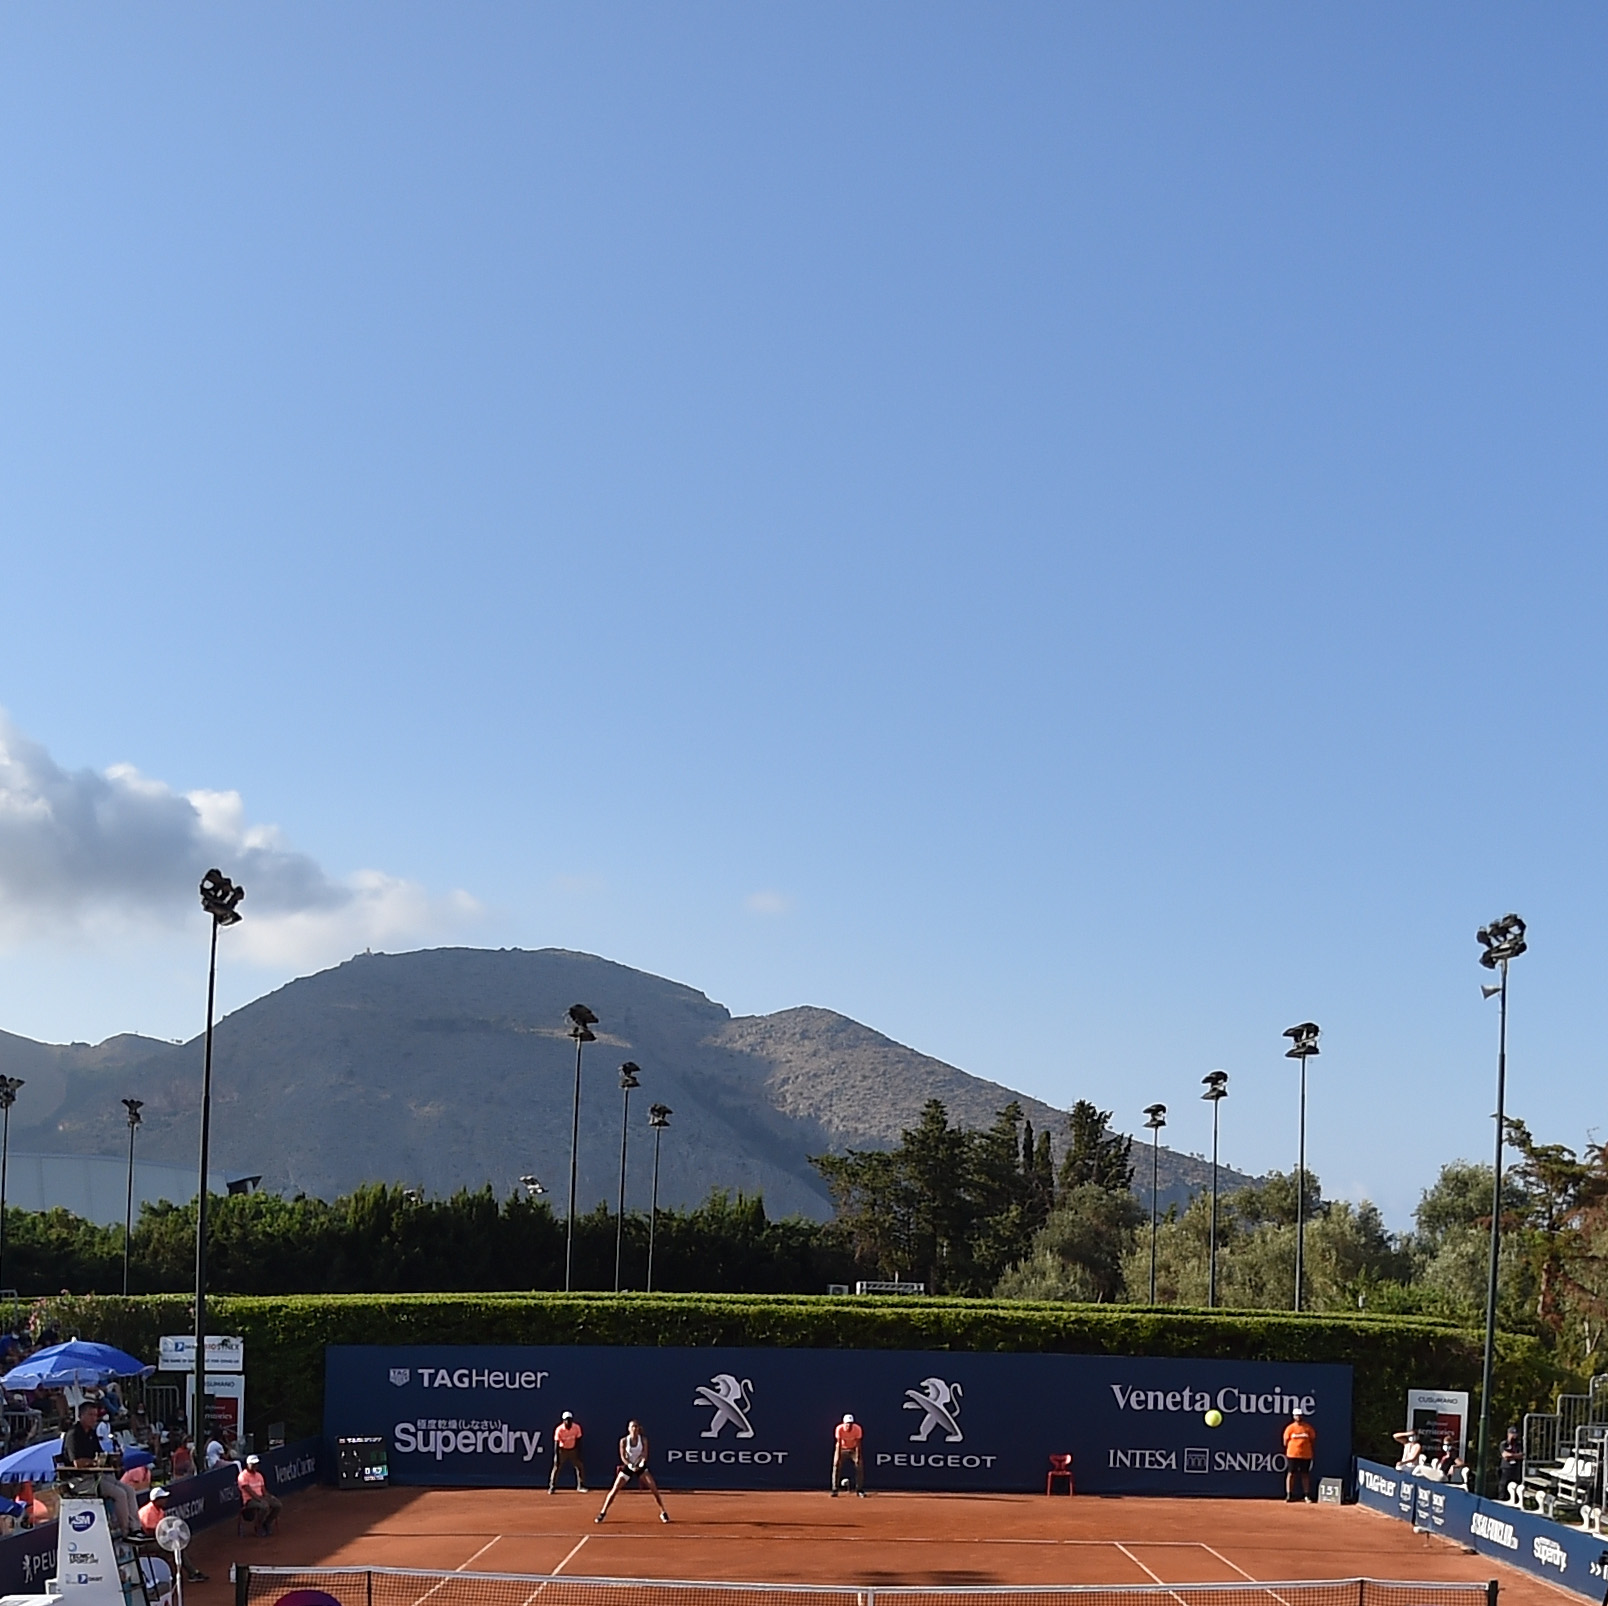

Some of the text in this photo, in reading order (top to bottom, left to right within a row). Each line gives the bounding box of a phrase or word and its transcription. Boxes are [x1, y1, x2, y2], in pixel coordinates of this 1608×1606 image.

[1110, 1384, 1316, 1416] Veneta Cucine
[667, 1449, 789, 1465] PEUGEOT
[876, 1453, 997, 1469] PEUGEOT
[1108, 1449, 1289, 1473] INTESA SANPAO
